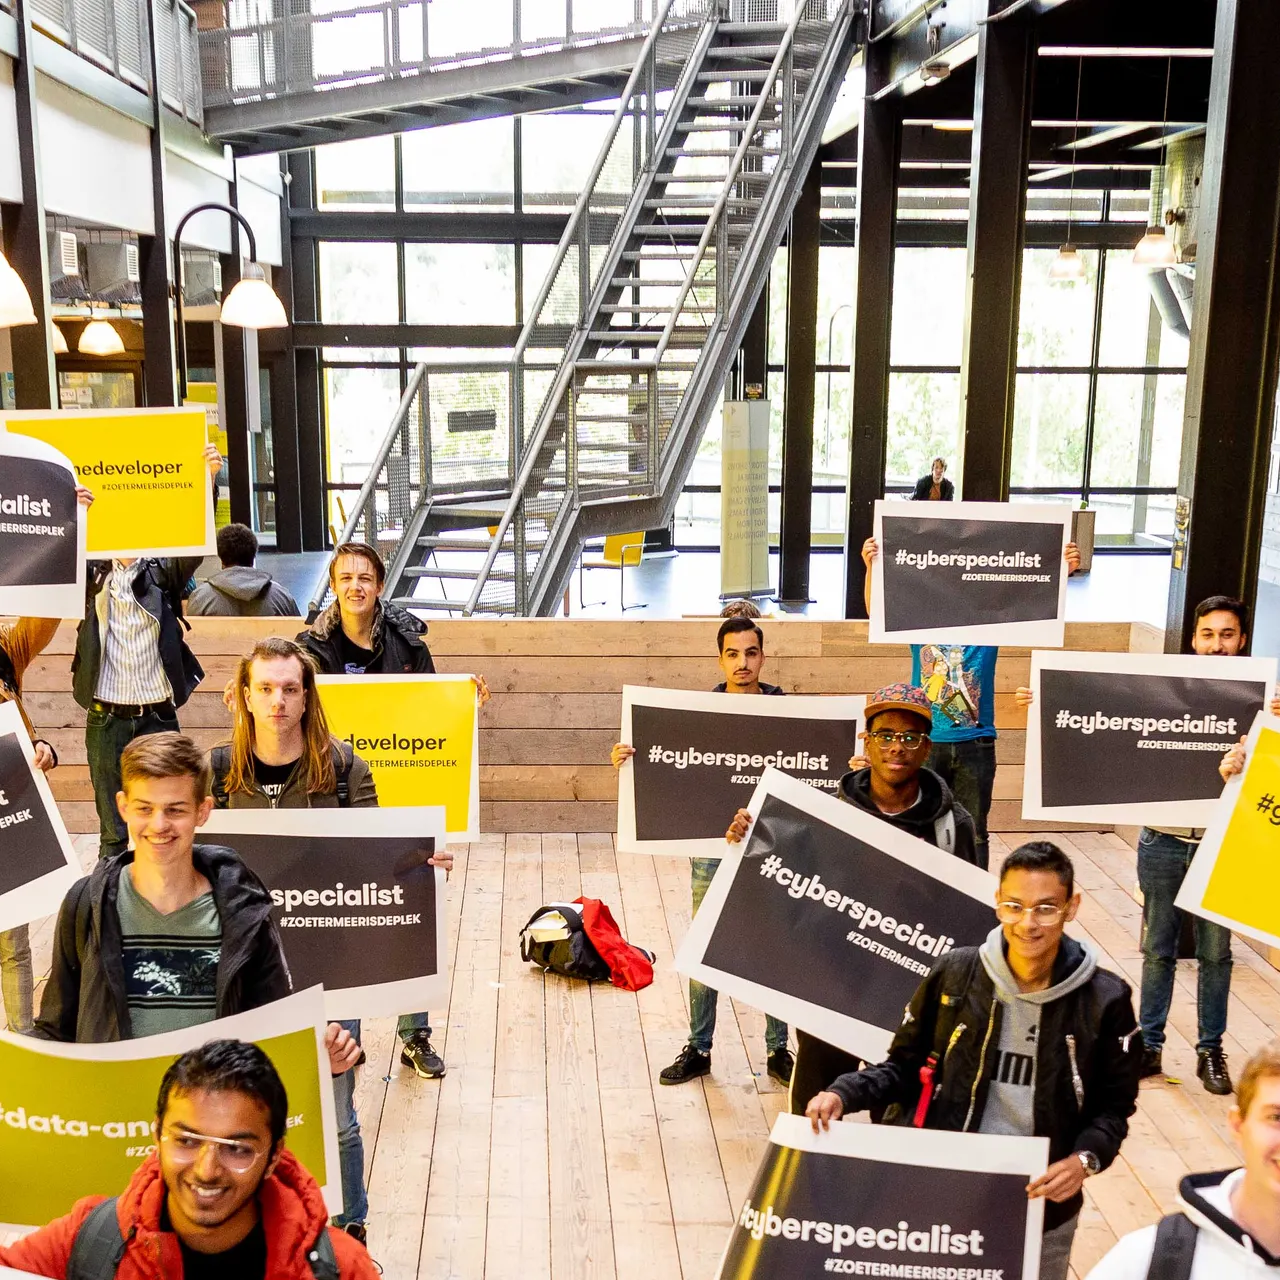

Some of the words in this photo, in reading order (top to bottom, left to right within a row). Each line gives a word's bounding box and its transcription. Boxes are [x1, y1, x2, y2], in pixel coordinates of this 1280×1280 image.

[102, 482, 194, 491] #ZOETERMEERISDEPLEK
[895, 548, 1042, 571] #cyberspecialist
[961, 573, 1051, 584] #ZOETERMEERISDEPLEK
[1056, 710, 1238, 736] #cyberspecialist
[343, 733, 447, 755] developer
[1137, 740, 1233, 752] #ZOETERMEERISDEP
[367, 759, 458, 768] ETERMEERISDEPLEK
[649, 745, 829, 771] #cyberspecialist
[268, 882, 404, 912] specialist
[760, 854, 955, 957] #cyberspeciali
[280, 914, 421, 927] #ZOETERMEERISDEPLEK
[846, 931, 931, 978] #ZOETERMEERI
[740, 1200, 984, 1256] #cyberspecialist
